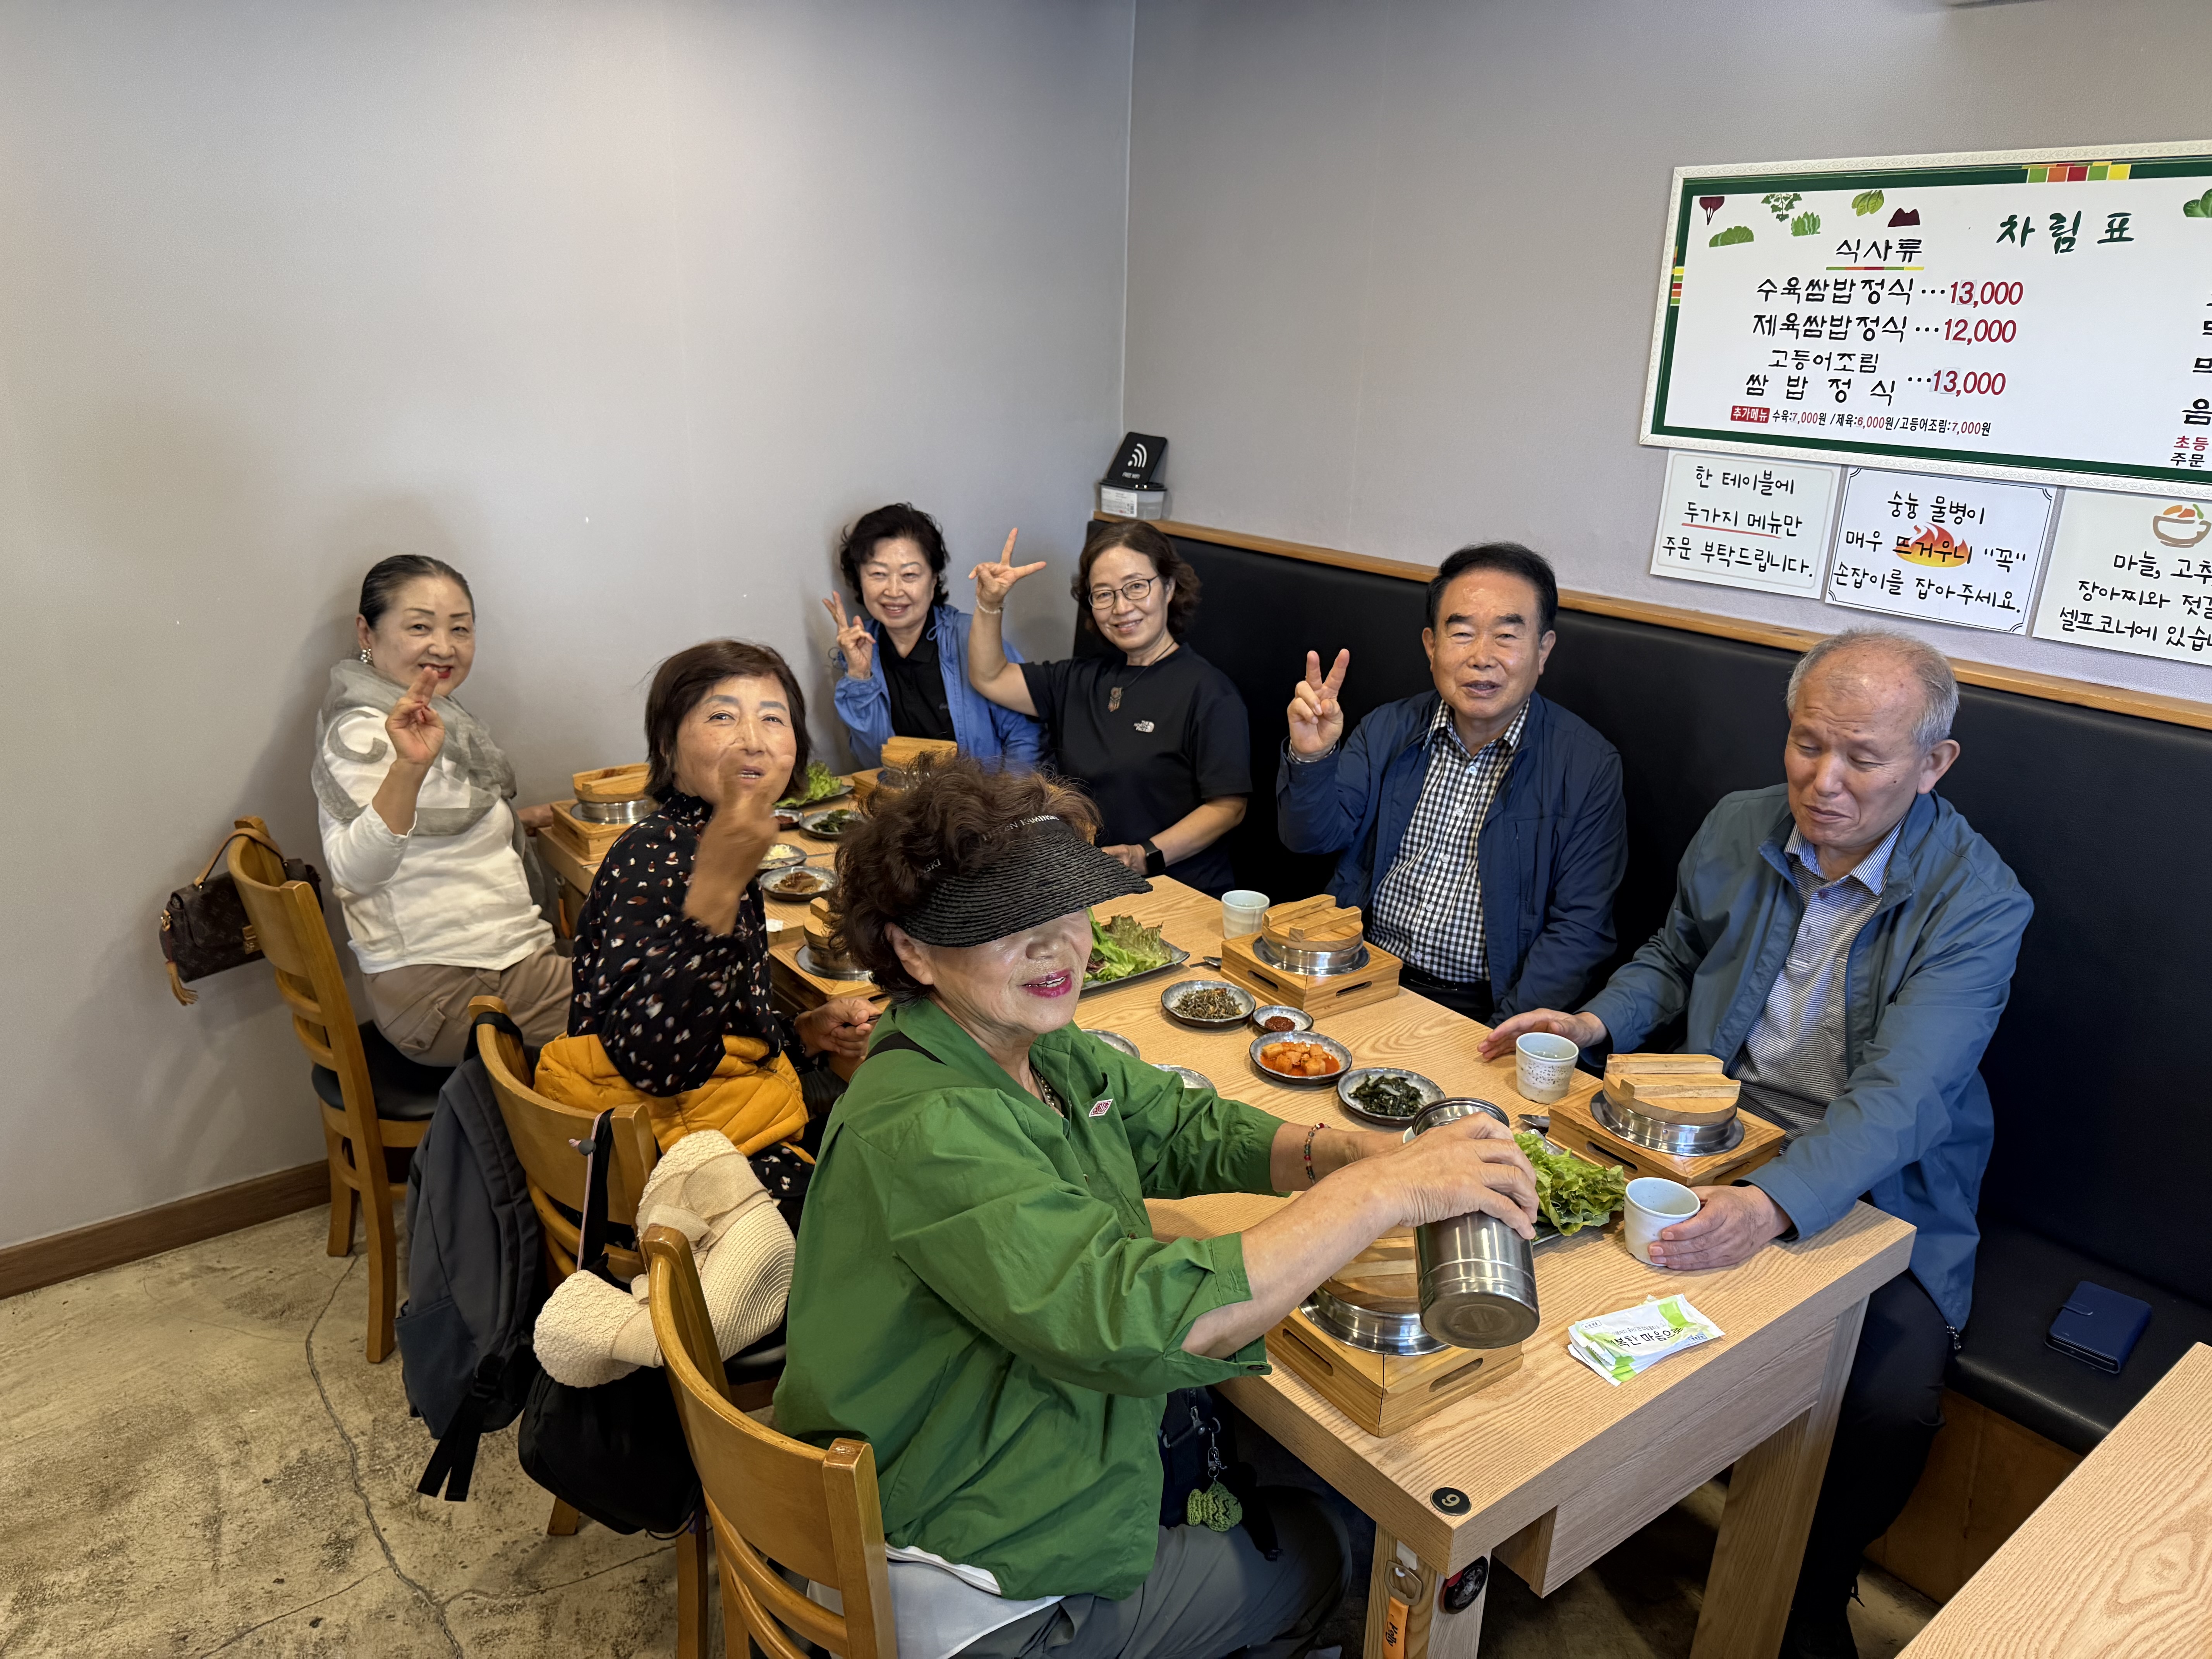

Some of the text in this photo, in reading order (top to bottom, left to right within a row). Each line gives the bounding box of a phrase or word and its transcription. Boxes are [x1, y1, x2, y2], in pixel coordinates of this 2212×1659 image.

[1836, 239, 1922, 263] 식사류
[1757, 277, 2023, 308] 수육쌈밥정식 13,000
[1753, 313, 2016, 345] 제육쌈밥정식 12,000
[1768, 350, 1879, 373] 고등어조림
[1933, 370, 2006, 397] 13,000
[1733, 407, 1767, 422] 추가메뉴
[1772, 409, 1826, 426] 수육:7,000원
[2173, 435, 2209, 451] 초등
[2170, 452, 2205, 467] 주문
[1696, 466, 1794, 496] 한 테이블에
[1685, 502, 1803, 537] 두가지 메뉴만
[1887, 491, 1985, 525] 숭늉 물병이
[1662, 537, 1813, 577] 주문 부탁드립니다.
[1846, 531, 1883, 552] 매우
[1892, 536, 1973, 564] 뜨거우니
[2114, 551, 2212, 587] 마늘, 고추
[1834, 562, 2020, 613] 손잡이를 잡아주세요.
[2078, 580, 2171, 609] 장아찌와
[2059, 607, 2157, 641] 셀프코너에
